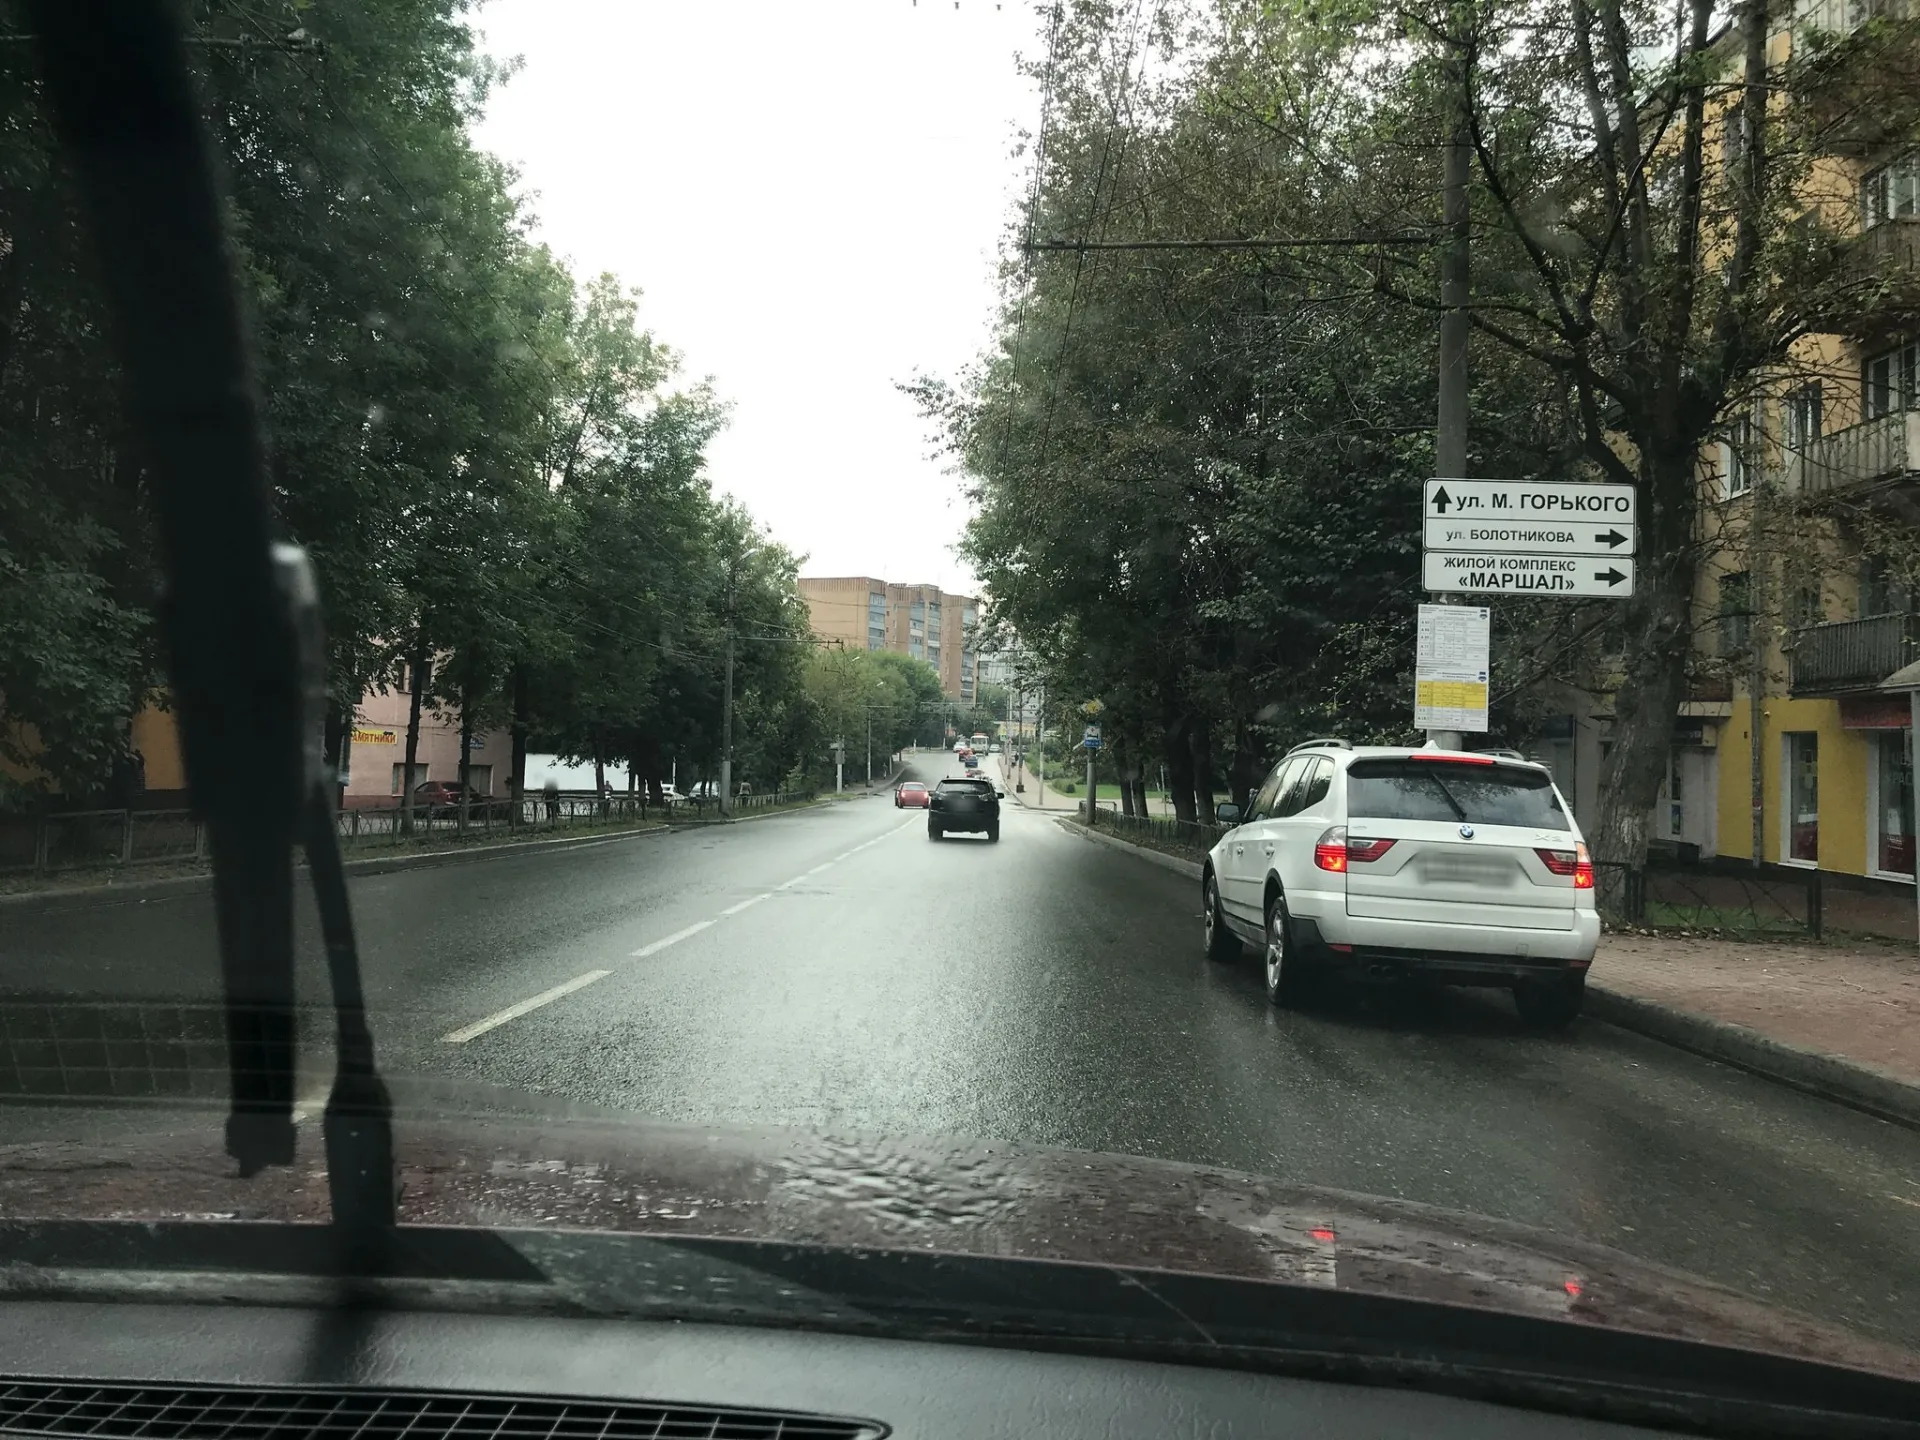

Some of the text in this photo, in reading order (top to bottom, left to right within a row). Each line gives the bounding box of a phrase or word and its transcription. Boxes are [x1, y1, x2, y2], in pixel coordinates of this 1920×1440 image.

[1456, 493, 1630, 513] ул. М. ГОРЬКОГО
[1446, 529, 1575, 543] ул. БОЛОТНИКОВА
[1444, 556, 1576, 572] ЖИЛОЙ КОМПЛЕКС
[1458, 572, 1575, 590] «МАРШАЛ»
[352, 733, 396, 743] АМЯТНИКИ
